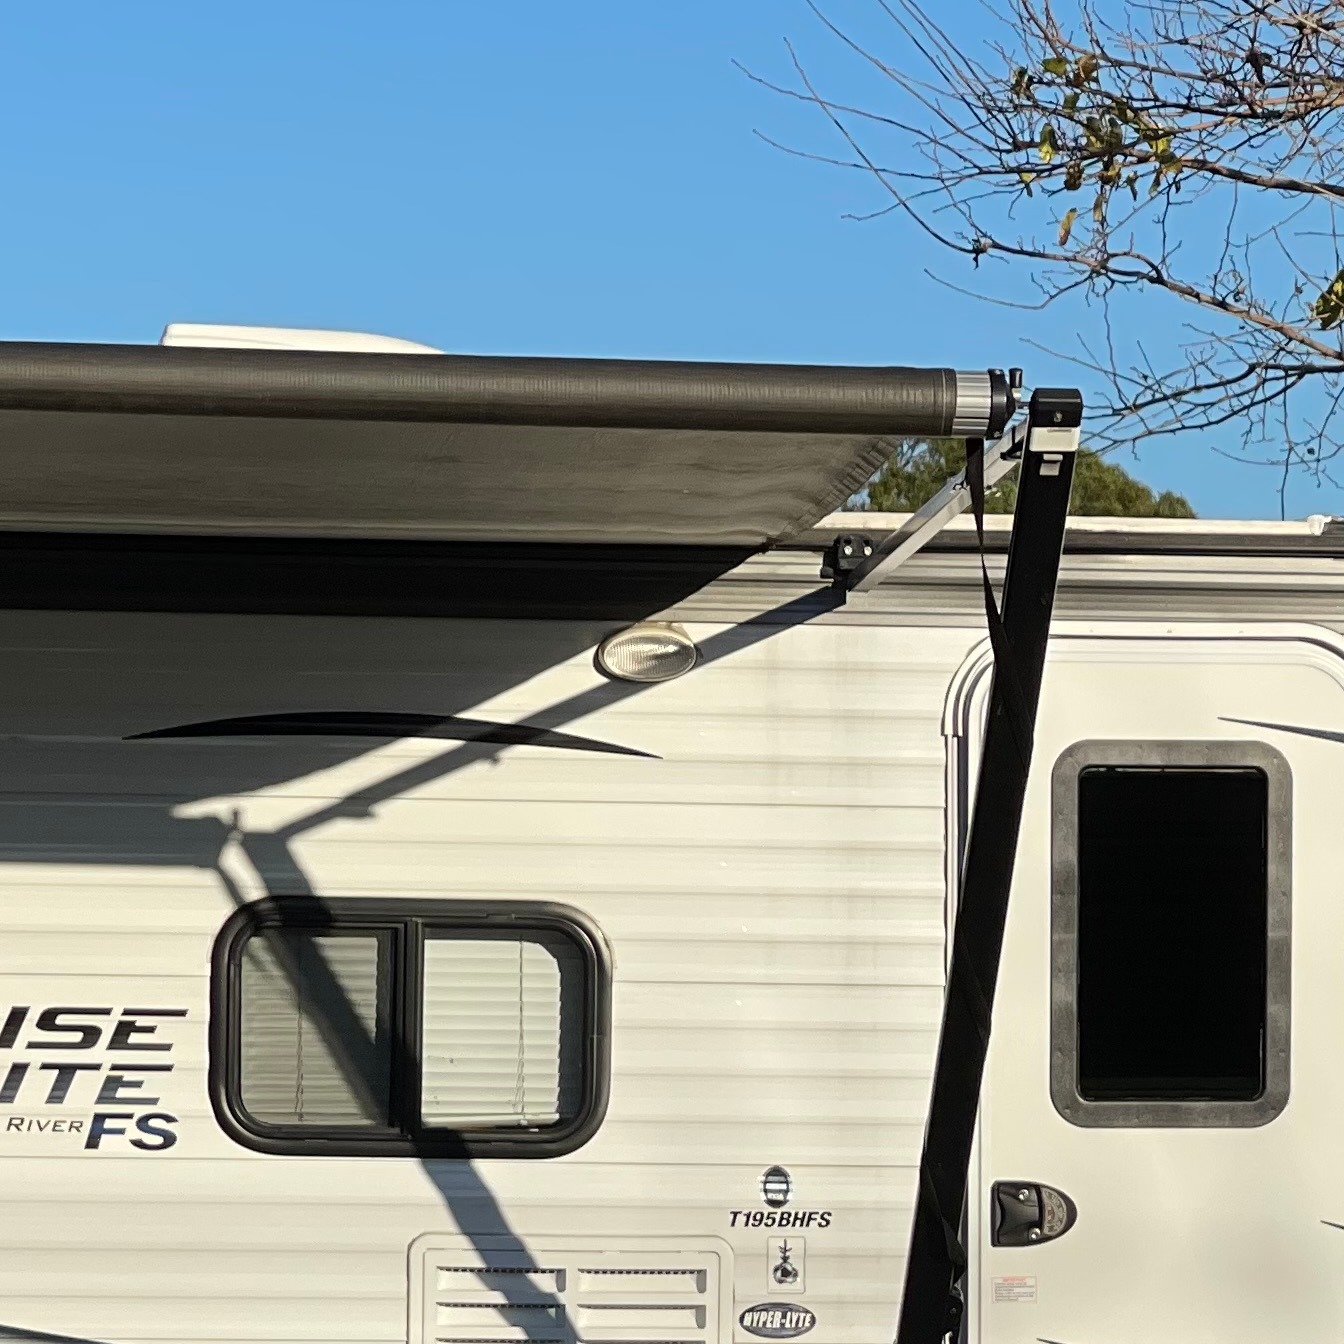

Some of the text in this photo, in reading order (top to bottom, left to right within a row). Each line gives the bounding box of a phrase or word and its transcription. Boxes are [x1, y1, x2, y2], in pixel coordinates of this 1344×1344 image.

[7, 1116, 84, 1133] RIVER
[84, 1112, 177, 1150] FS
[730, 1211, 831, 1228] T195BHFS
[743, 1310, 812, 1329] HYPER-LYTE
